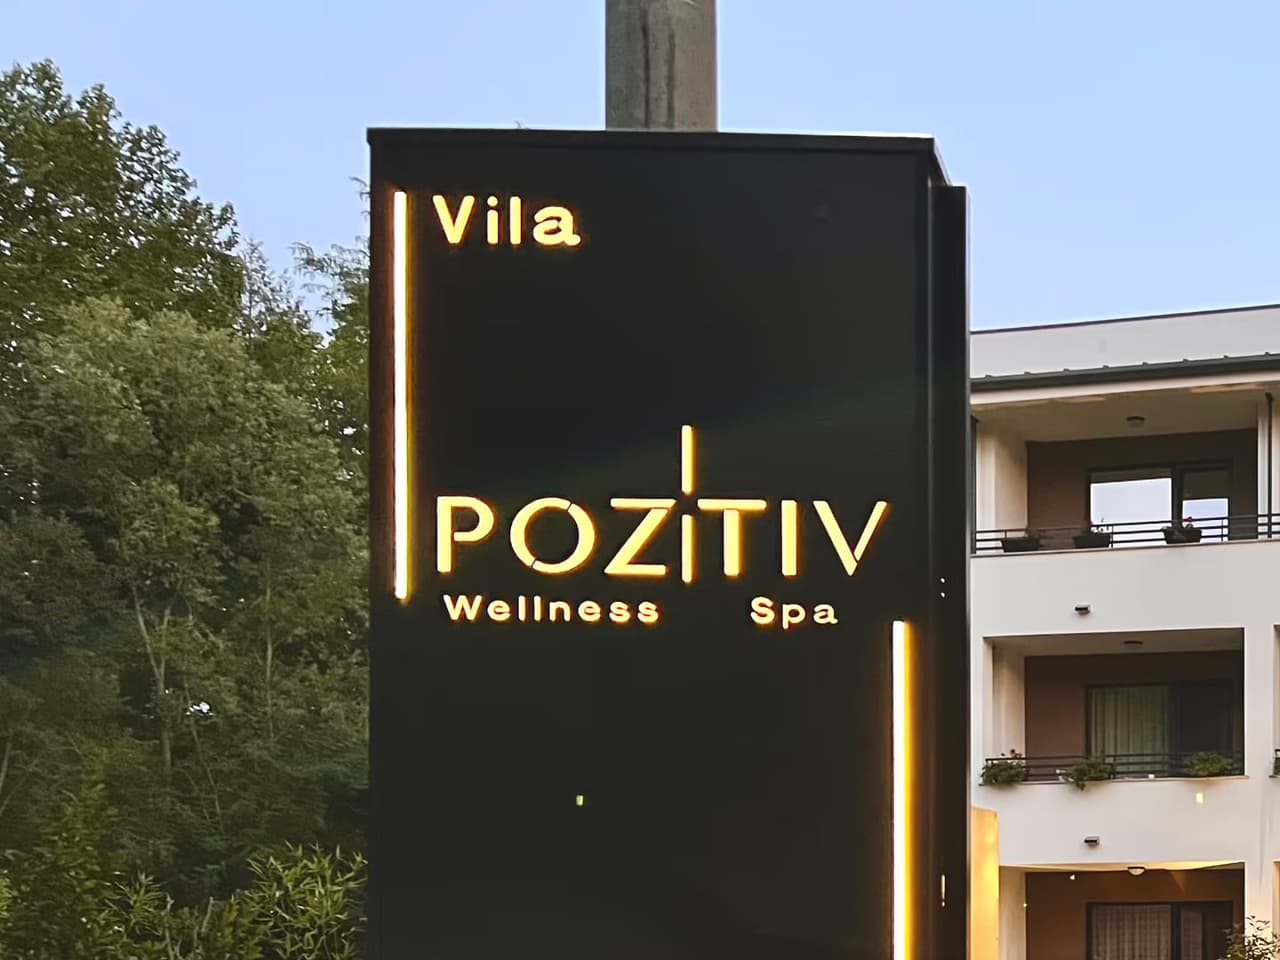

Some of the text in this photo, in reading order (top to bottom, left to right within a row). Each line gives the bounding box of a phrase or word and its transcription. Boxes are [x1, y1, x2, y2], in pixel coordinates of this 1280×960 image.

[432, 194, 582, 247] Vila
[443, 594, 839, 630] Wellness Spa
